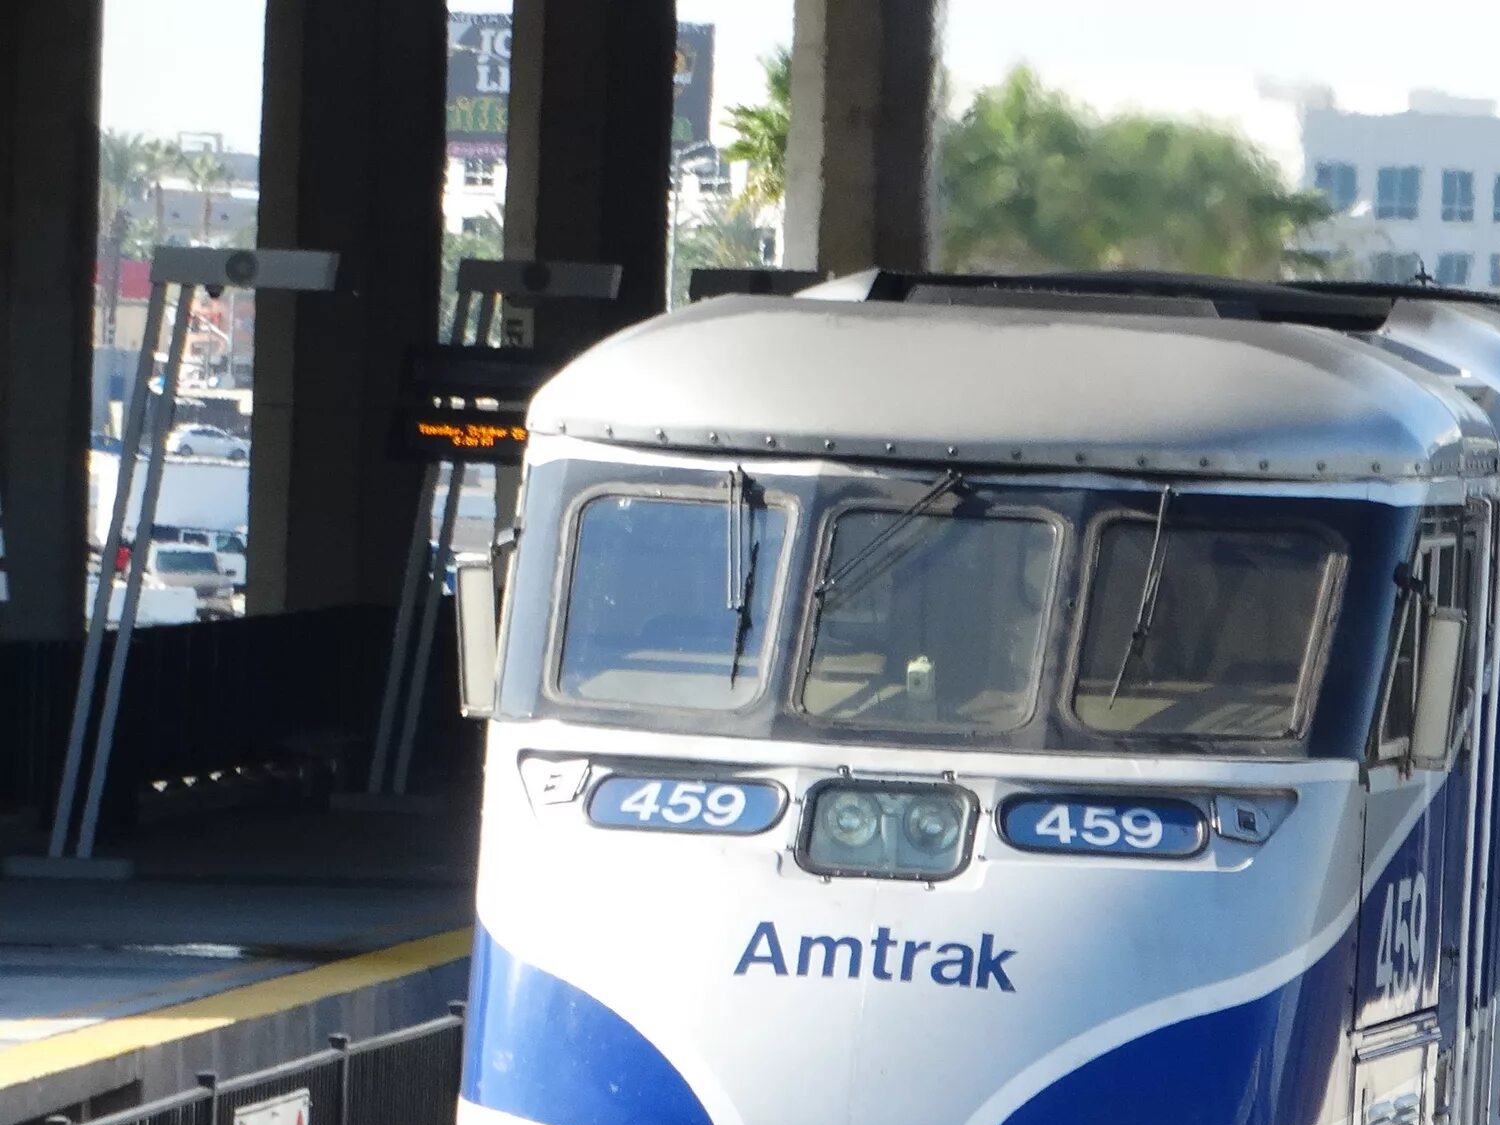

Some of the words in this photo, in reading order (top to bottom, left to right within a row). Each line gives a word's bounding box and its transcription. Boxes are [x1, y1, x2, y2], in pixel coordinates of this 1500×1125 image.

[620, 779, 746, 827] 459
[1035, 803, 1163, 849] 459
[733, 921, 1018, 993] Amtrak
[1376, 871, 1426, 1000] 459
